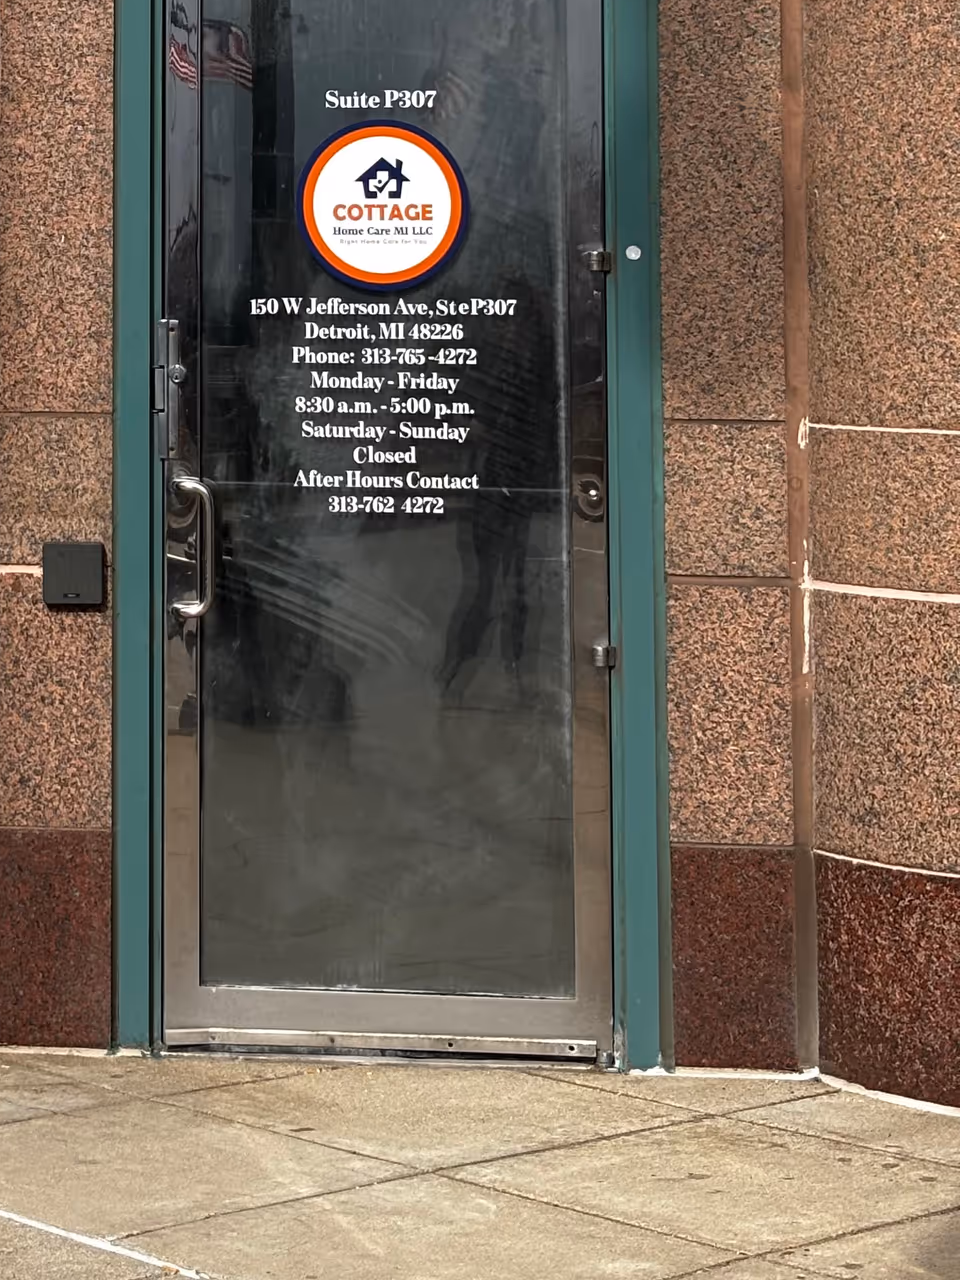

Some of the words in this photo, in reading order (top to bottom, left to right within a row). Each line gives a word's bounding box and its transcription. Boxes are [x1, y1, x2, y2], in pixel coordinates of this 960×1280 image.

[325, 89, 381, 109] Suite
[383, 89, 437, 109] P307
[332, 203, 433, 221] COTTAGE
[332, 226, 365, 236] Home
[367, 226, 391, 236] Care
[393, 226, 408, 236] MI
[412, 227, 433, 236] LLC
[250, 297, 279, 316] 150
[281, 297, 303, 316] W
[305, 297, 391, 316] Jefferson
[393, 297, 434, 319] Ave,
[304, 321, 376, 343] Detroit,
[378, 322, 405, 340] MI
[407, 323, 464, 340] 48226
[291, 346, 355, 365] Phone:
[309, 370, 386, 394] Monday
[397, 371, 460, 395] Friday
[294, 396, 335, 414] 8:30
[337, 401, 378, 414] a.m.
[389, 397, 431, 415] 5:00
[434, 402, 475, 419] p.m.
[301, 420, 387, 443] Saturday
[399, 421, 470, 444] Sunday
[352, 445, 417, 464] Closed
[293, 469, 344, 488] After
[345, 470, 404, 489] Hours
[405, 471, 480, 490] Contact
[328, 495, 395, 513] 313-762
[400, 496, 444, 514] 4272
